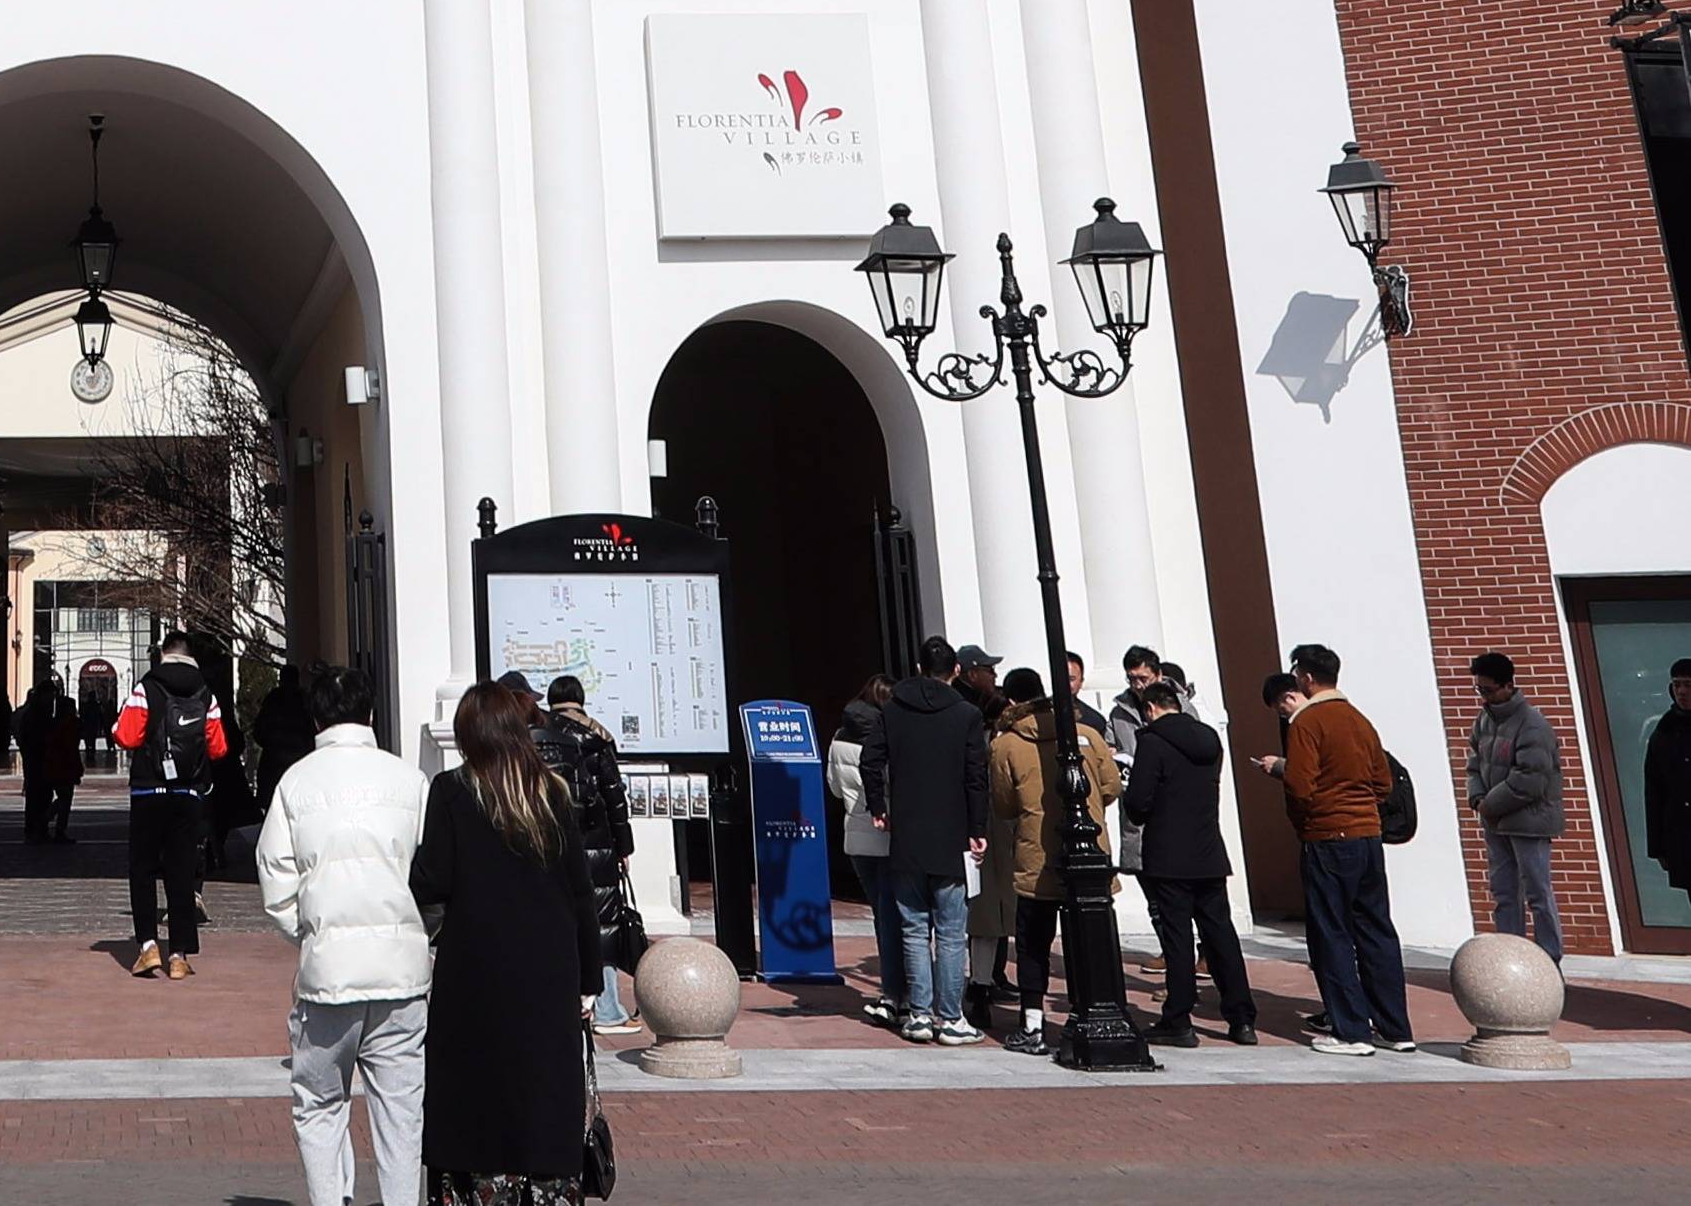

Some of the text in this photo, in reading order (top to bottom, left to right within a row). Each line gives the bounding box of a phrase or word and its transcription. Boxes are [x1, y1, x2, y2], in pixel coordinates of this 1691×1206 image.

[676, 113, 789, 129] FLORENTIA
[723, 130, 862, 145] VILLAGE
[780, 150, 864, 165] 佛罗伦萨小镇
[757, 721, 802, 733] 营业时间
